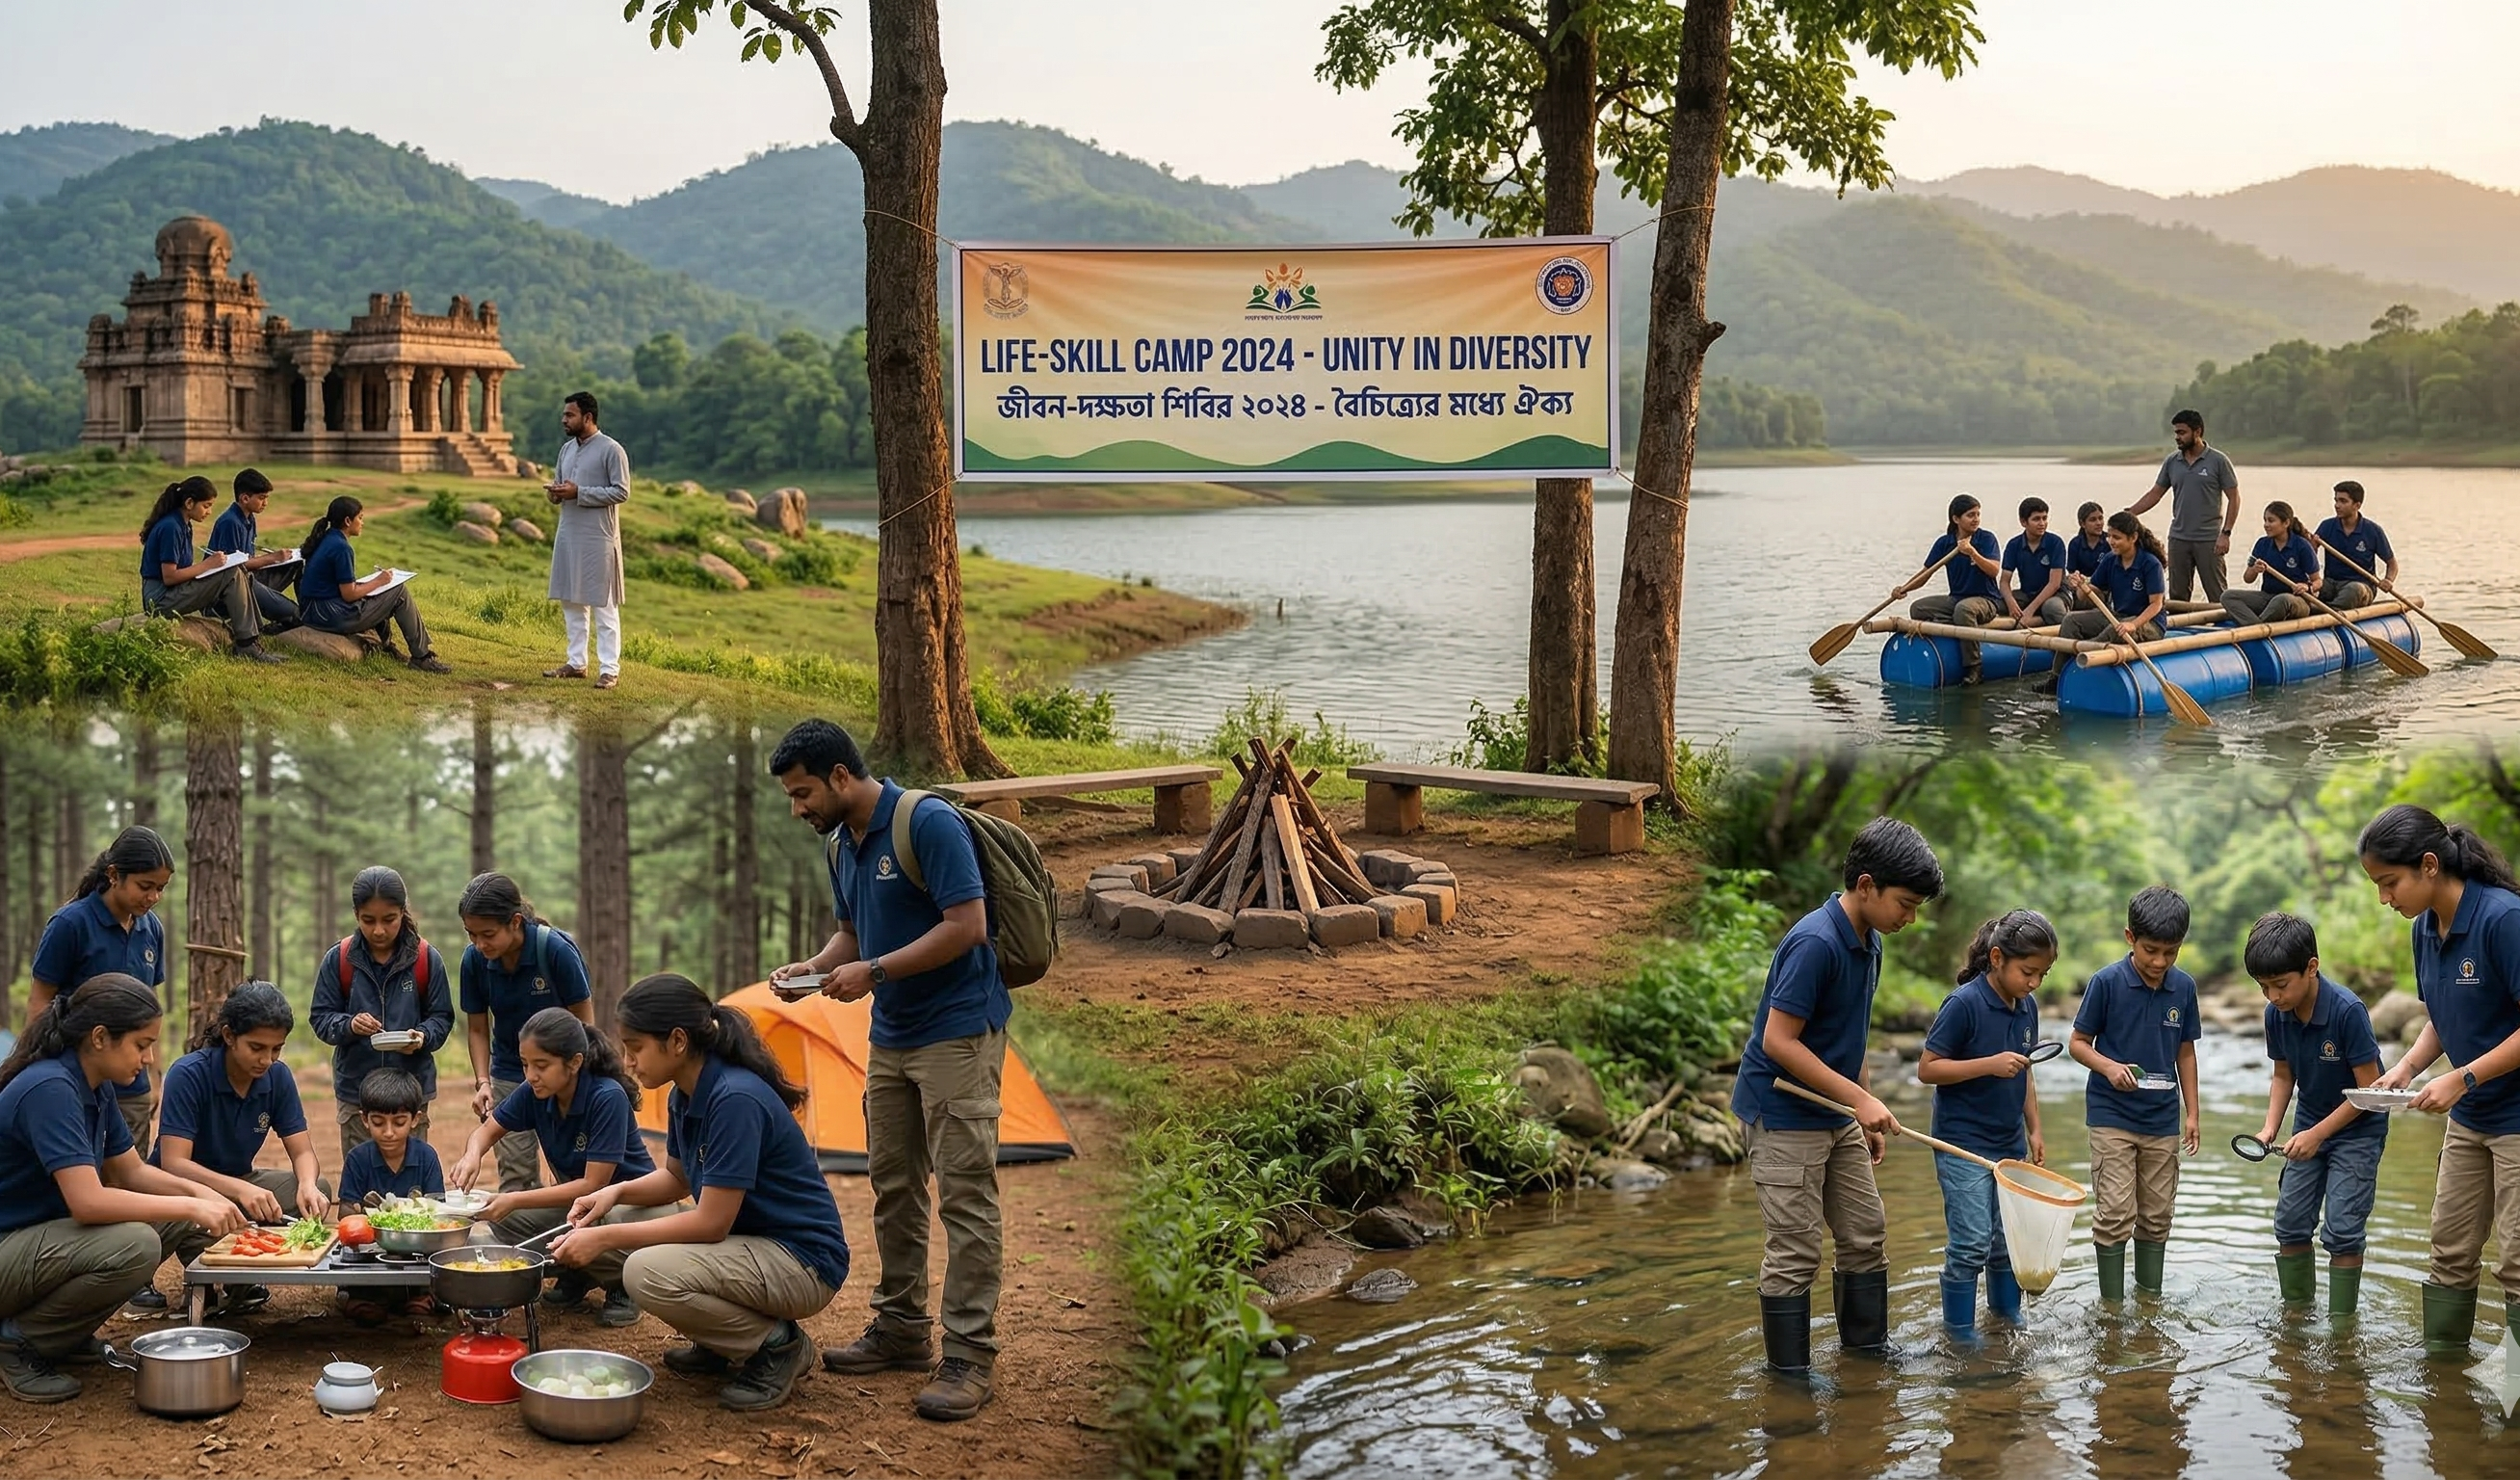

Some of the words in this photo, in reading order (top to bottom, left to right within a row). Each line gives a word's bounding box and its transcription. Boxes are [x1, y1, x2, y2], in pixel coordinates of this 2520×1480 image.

[981, 337, 1127, 374] LIFE-SKILL
[1134, 337, 1214, 374] CAMP
[1221, 337, 1295, 373] 2024
[1323, 336, 1405, 372] UNITY
[1413, 336, 1440, 371] IN
[1449, 334, 1592, 370] DIVERSITY
[996, 384, 1156, 419] জীবন-দক্ষতা
[1161, 385, 1234, 419] শিবির
[1242, 393, 1306, 419] ২০২৪
[1330, 385, 1442, 418] বৈচিত্র্যের
[1447, 391, 1507, 416] মধ্যে
[1513, 384, 1575, 416] ঐক্য
